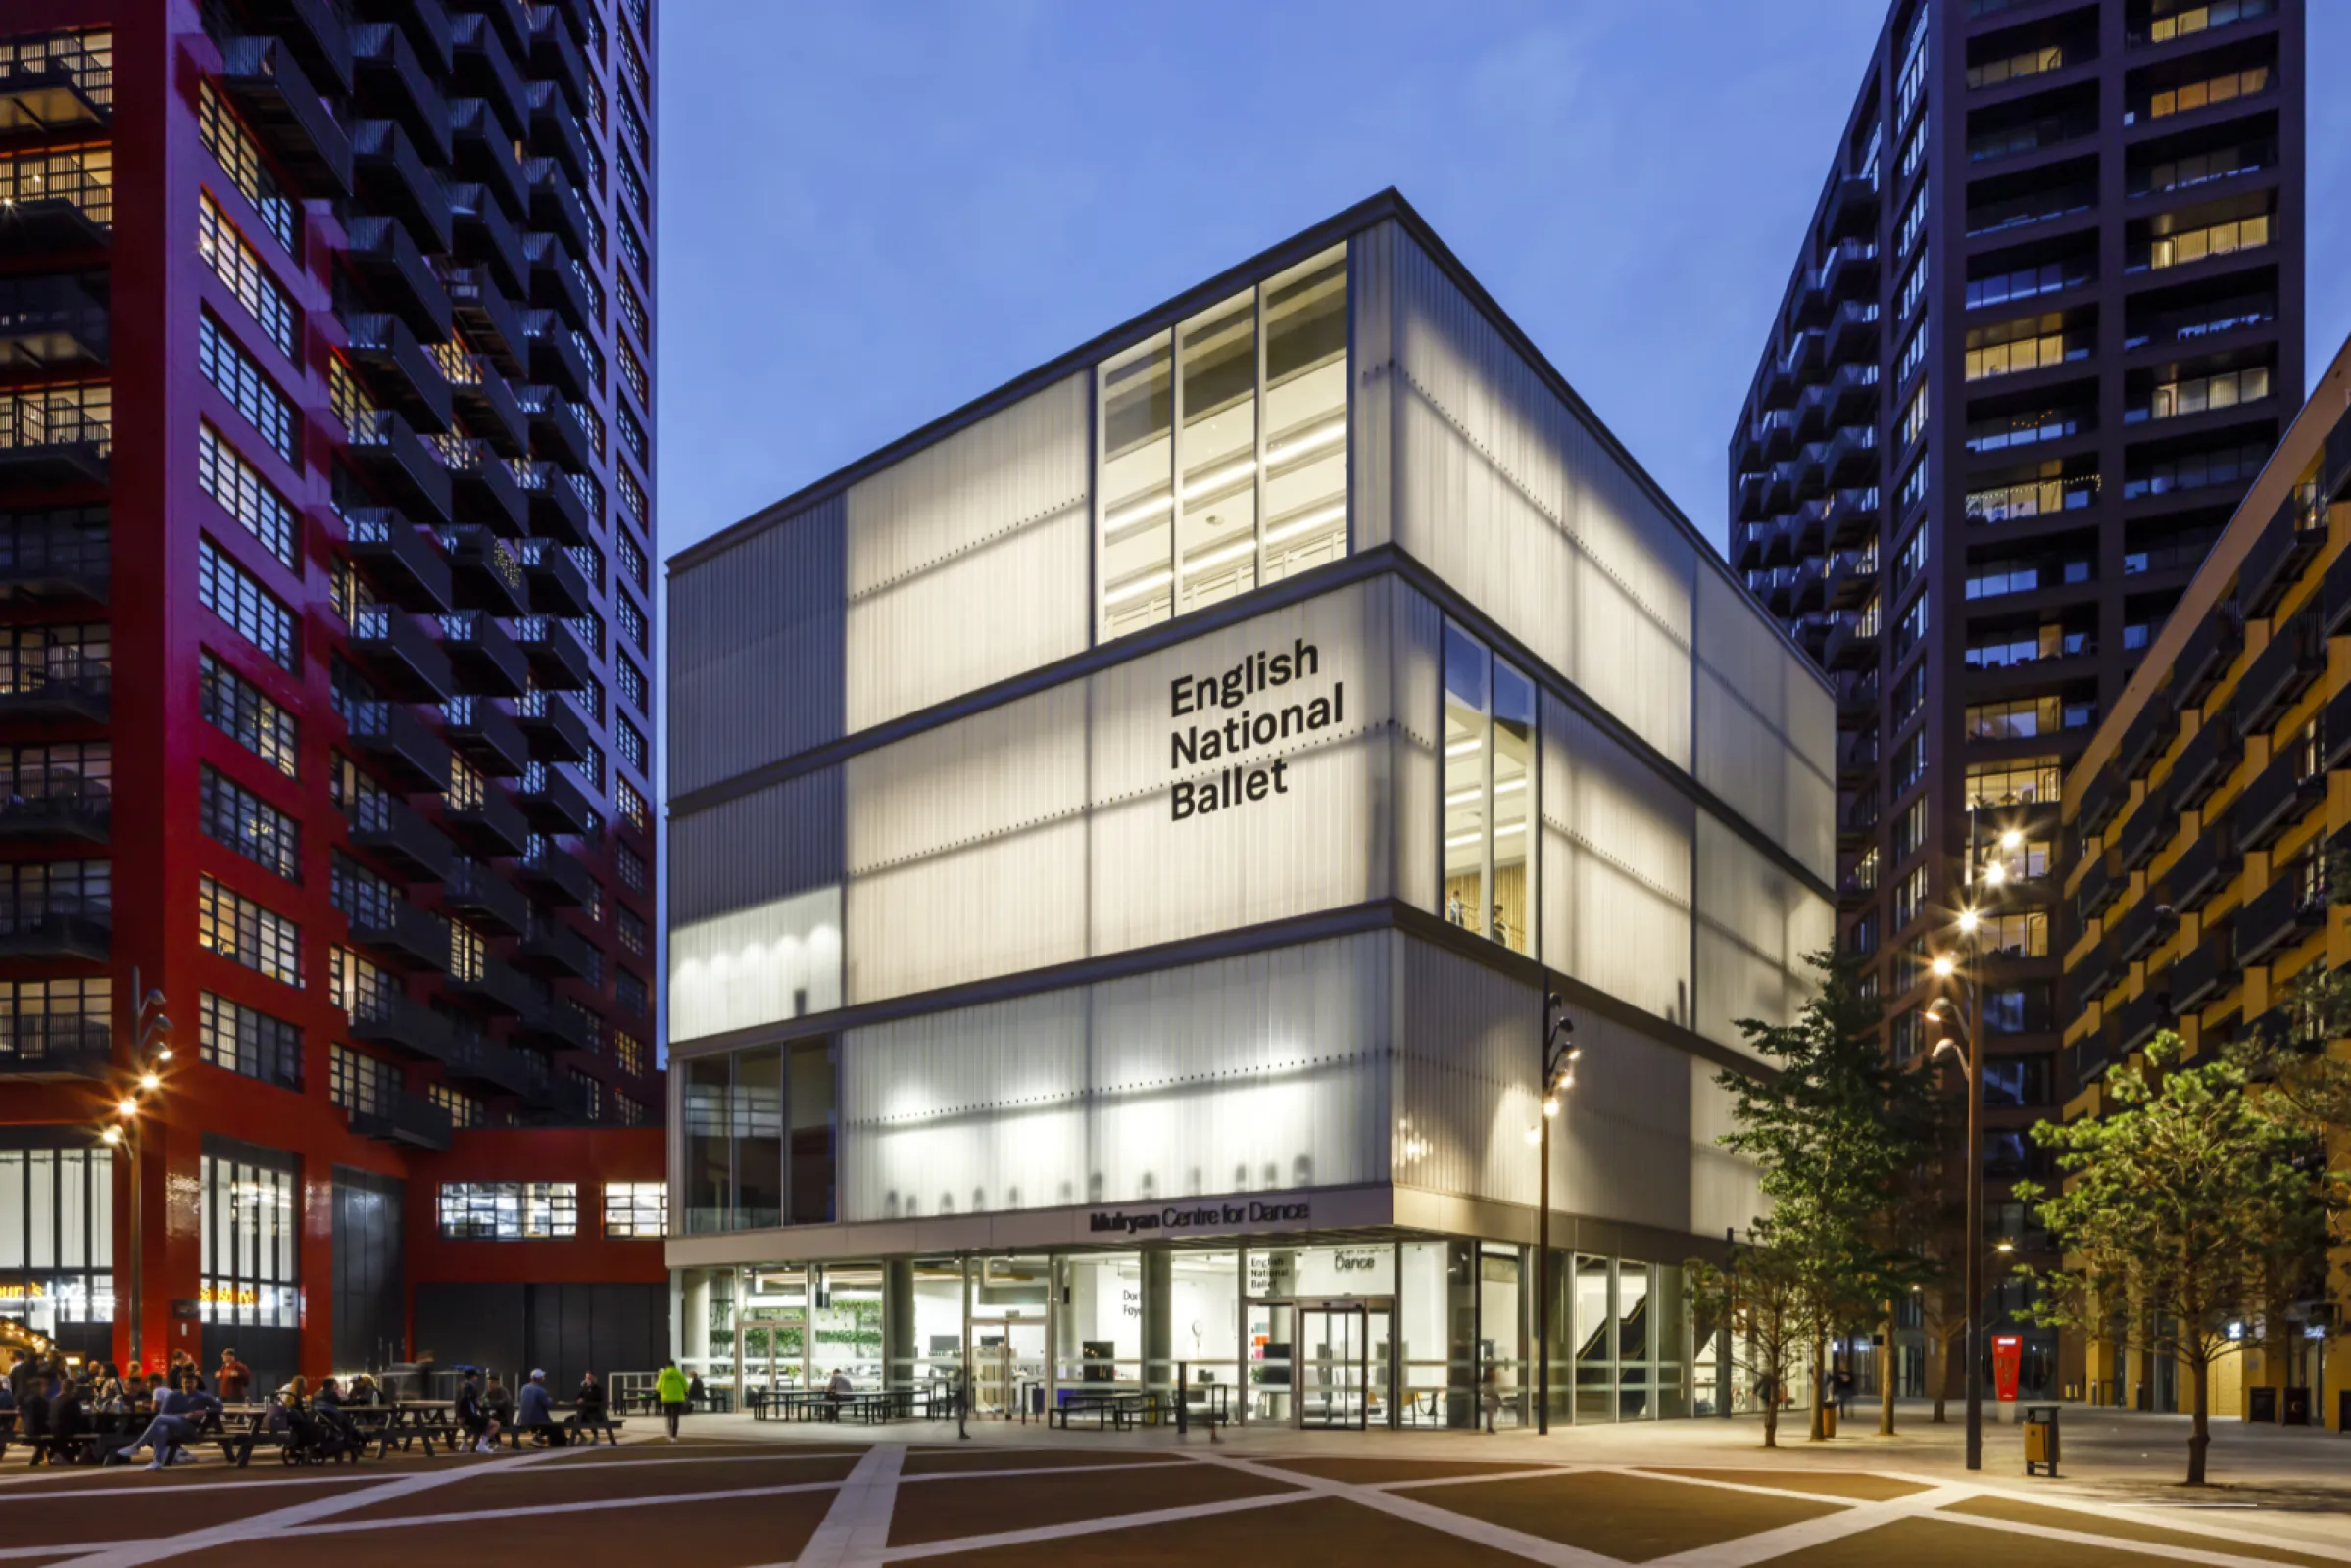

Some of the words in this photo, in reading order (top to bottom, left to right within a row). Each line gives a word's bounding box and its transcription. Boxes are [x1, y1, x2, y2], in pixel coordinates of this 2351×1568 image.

[1170, 638, 1319, 718] English
[1170, 681, 1344, 769] National
[1170, 758, 1288, 821] Ballet
[1090, 1211, 1160, 1234] Mulryan
[1162, 1206, 1218, 1228] Centre
[1222, 1203, 1245, 1224] for
[1249, 1200, 1309, 1222] Dance
[1250, 1257, 1284, 1268] English
[1250, 1268, 1290, 1278] National
[1334, 1255, 1376, 1271] Dance
[1250, 1279, 1277, 1289] Ballet
